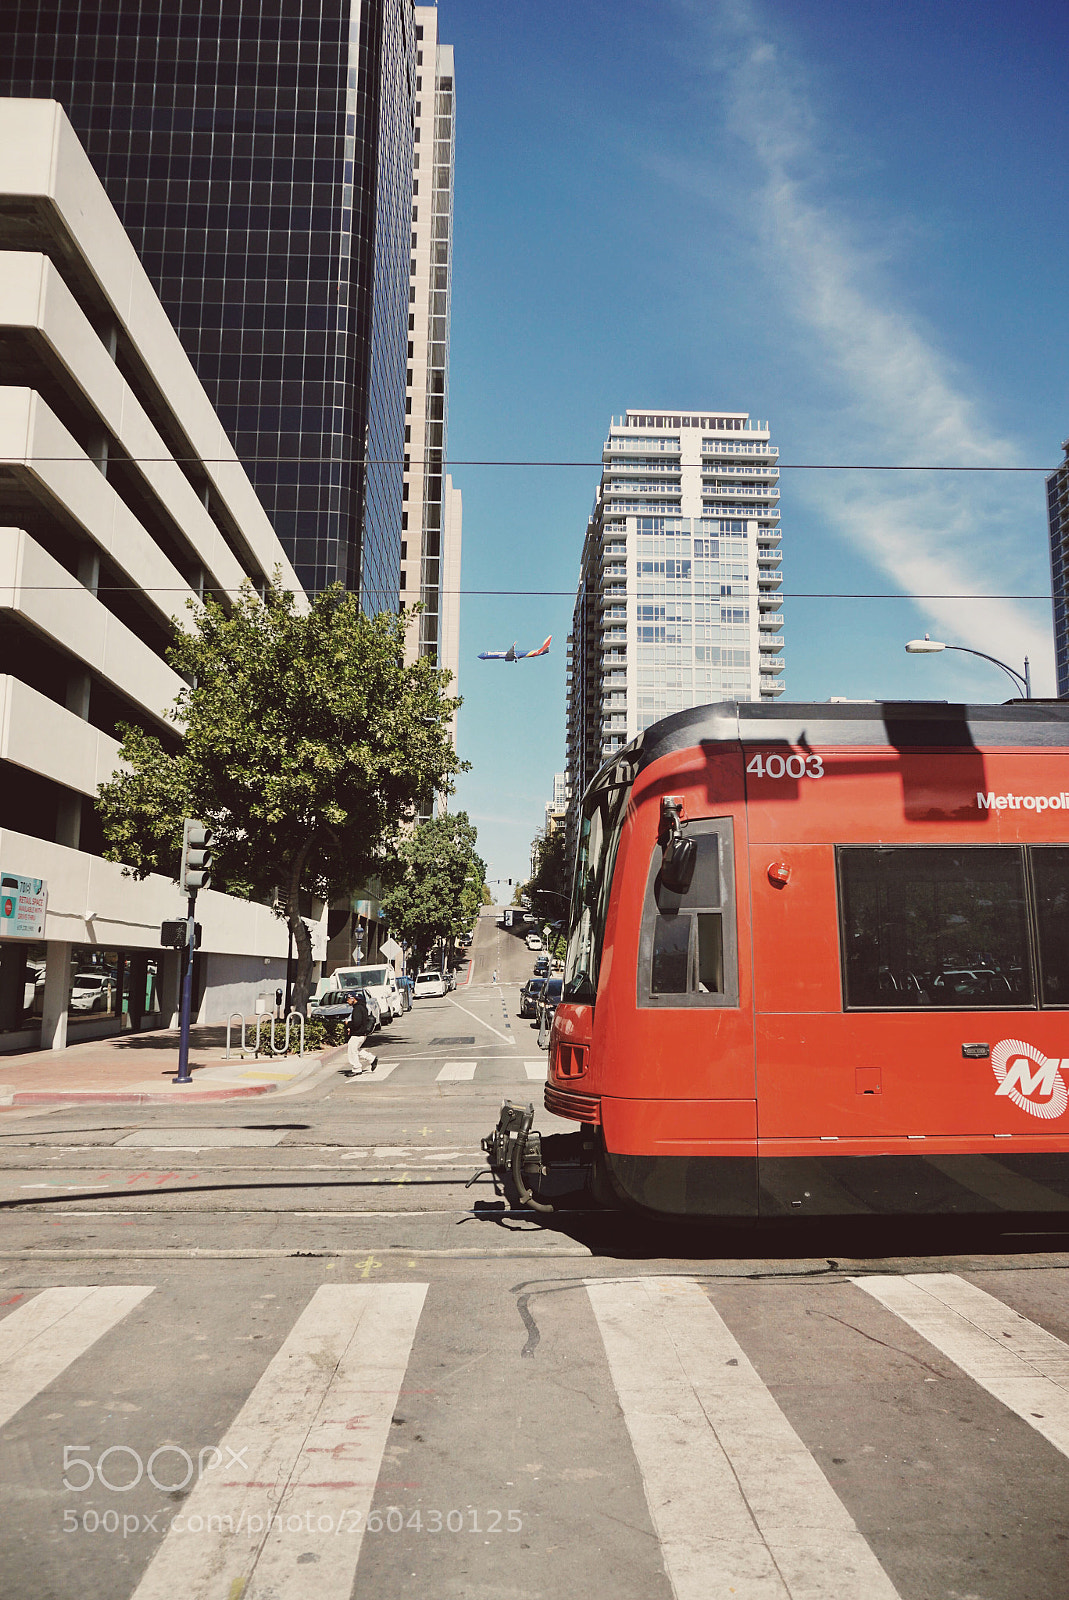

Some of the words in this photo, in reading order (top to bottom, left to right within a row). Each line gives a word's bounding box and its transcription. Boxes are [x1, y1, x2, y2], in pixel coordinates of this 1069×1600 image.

[746, 754, 825, 779] 4003
[976, 792, 1069, 813] Metropoli
[19, 896, 31, 905] RETAIL
[32, 898, 44, 906] SPACE
